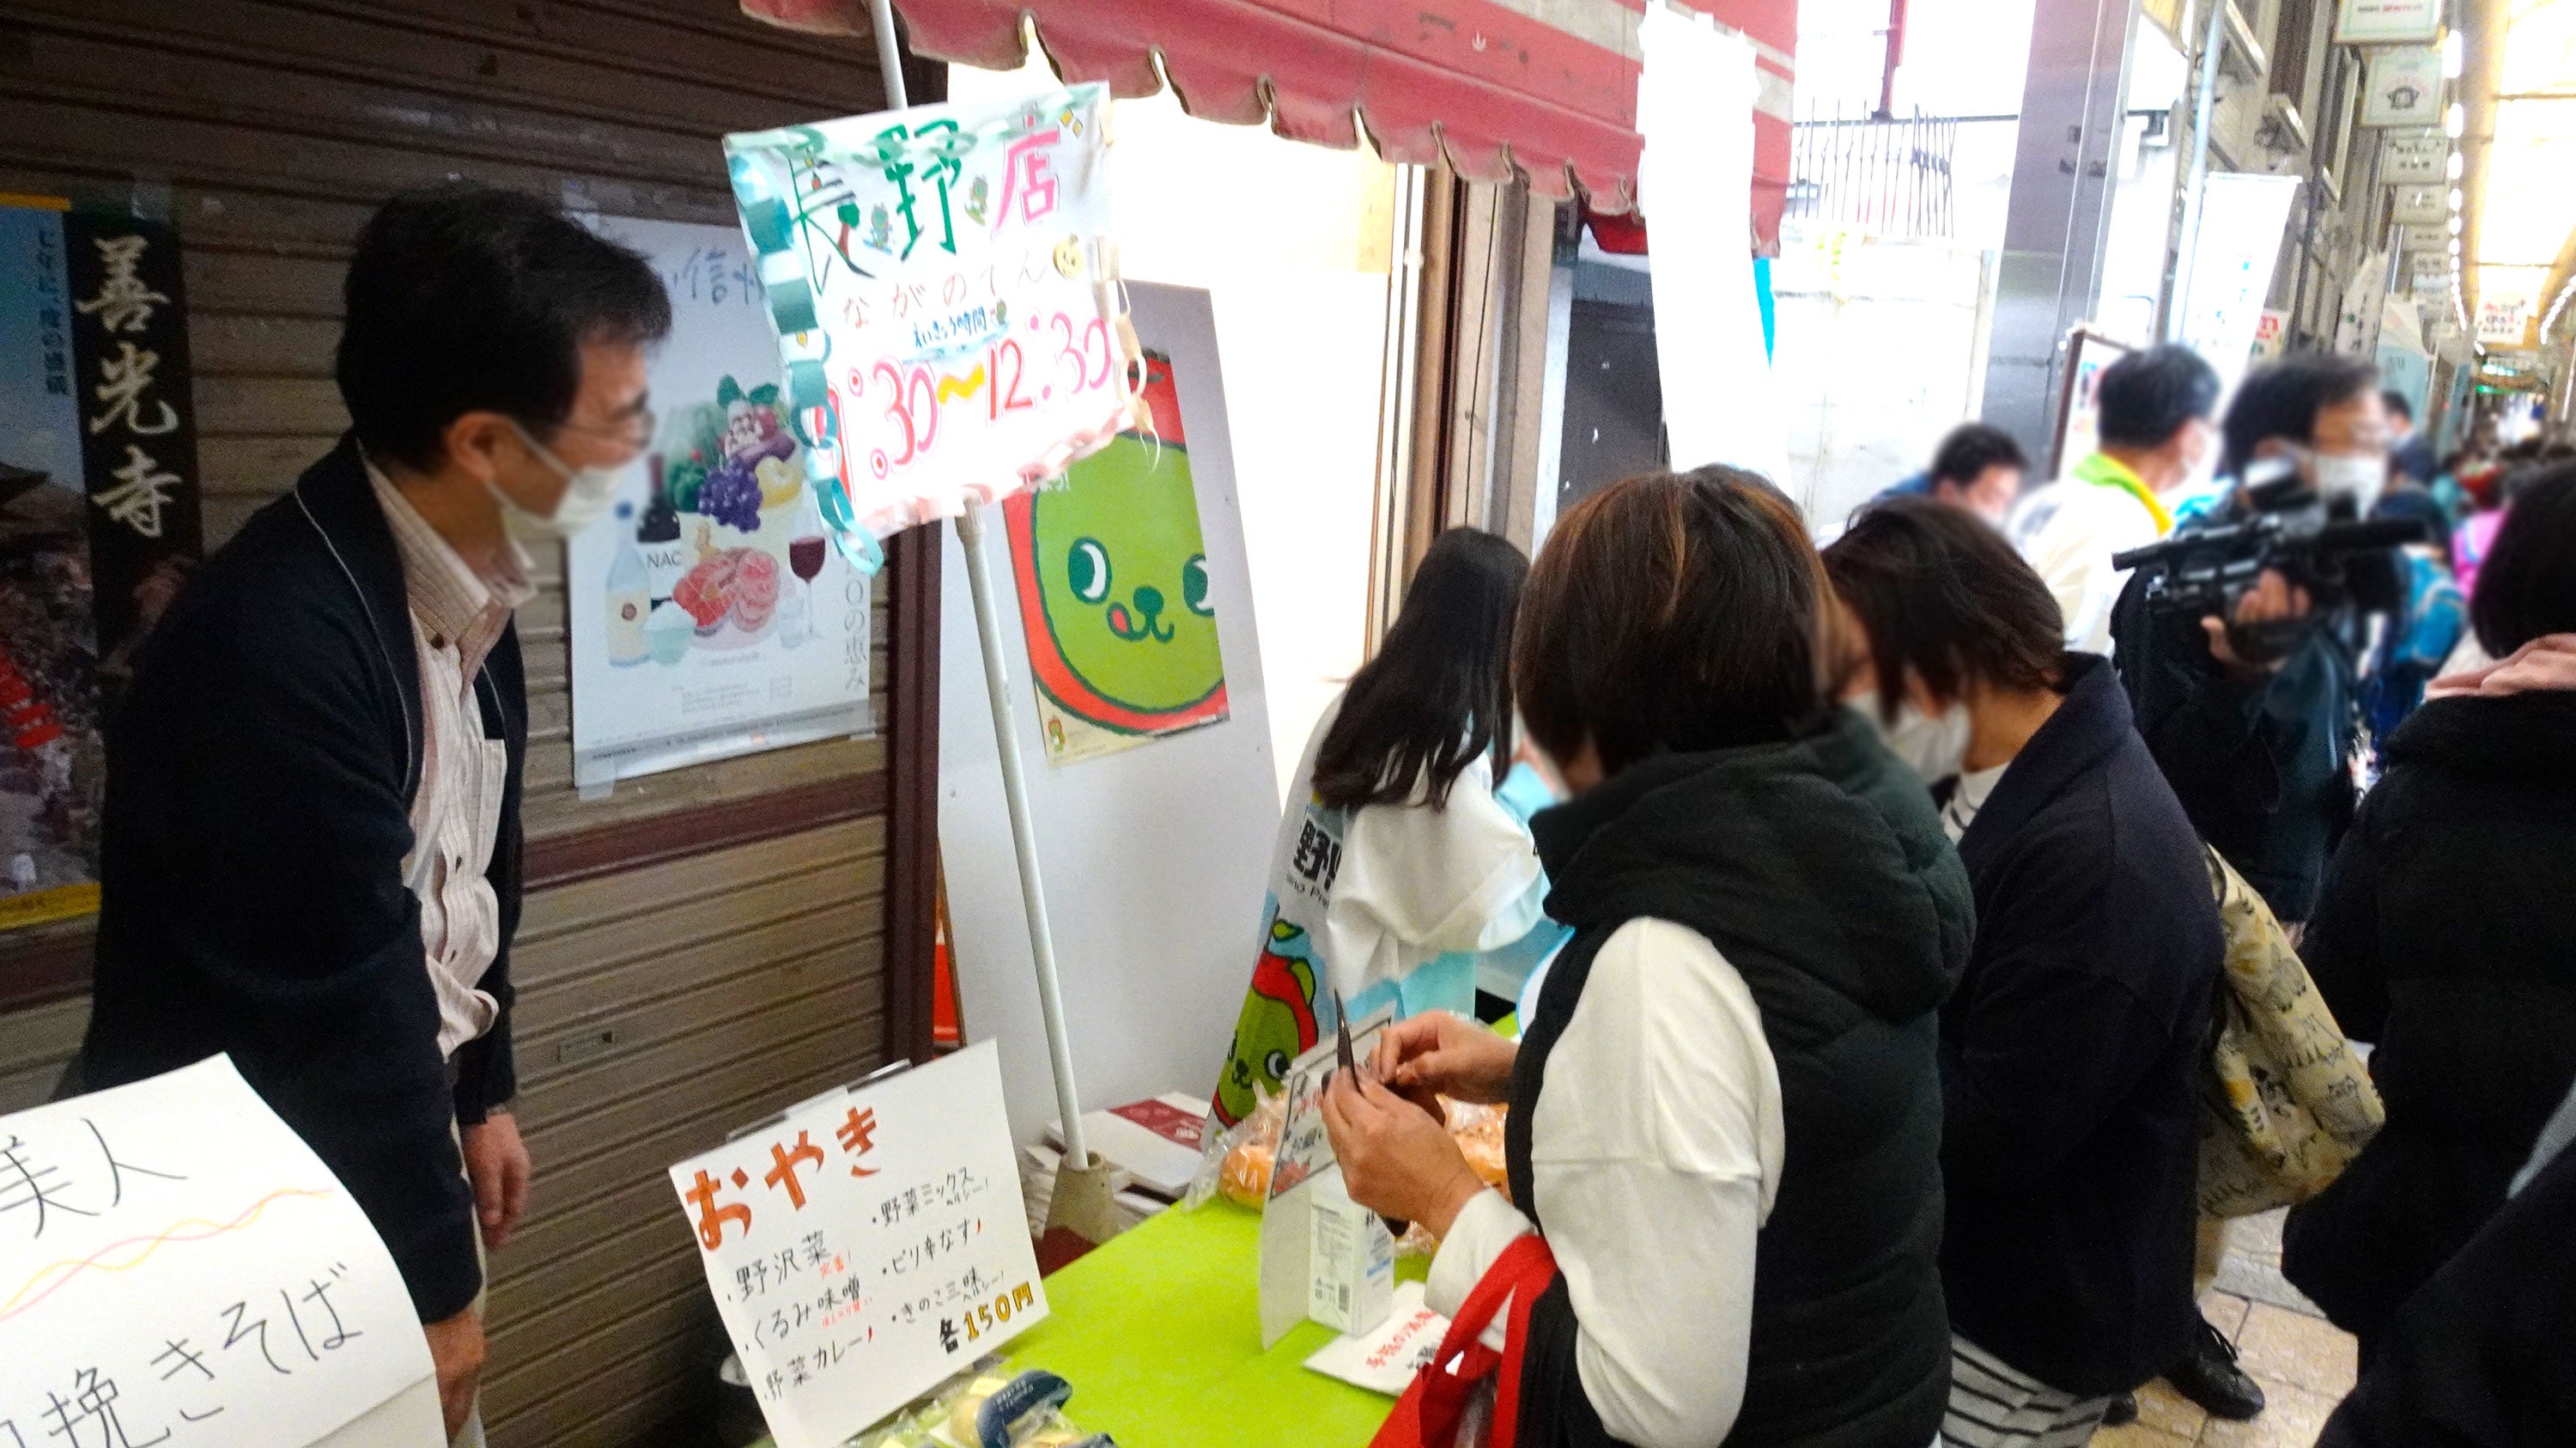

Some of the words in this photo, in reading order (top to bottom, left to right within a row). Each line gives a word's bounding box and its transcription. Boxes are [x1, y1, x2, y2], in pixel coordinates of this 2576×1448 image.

[790, 101, 1060, 295] 長野店
[843, 252, 1048, 329] ながのてん
[75, 234, 182, 538] 善光寺
[685, 1105, 882, 1251] おやき
[0, 1261, 364, 1448] 挽きそば
[939, 1281, 1035, 1354] 各150円
